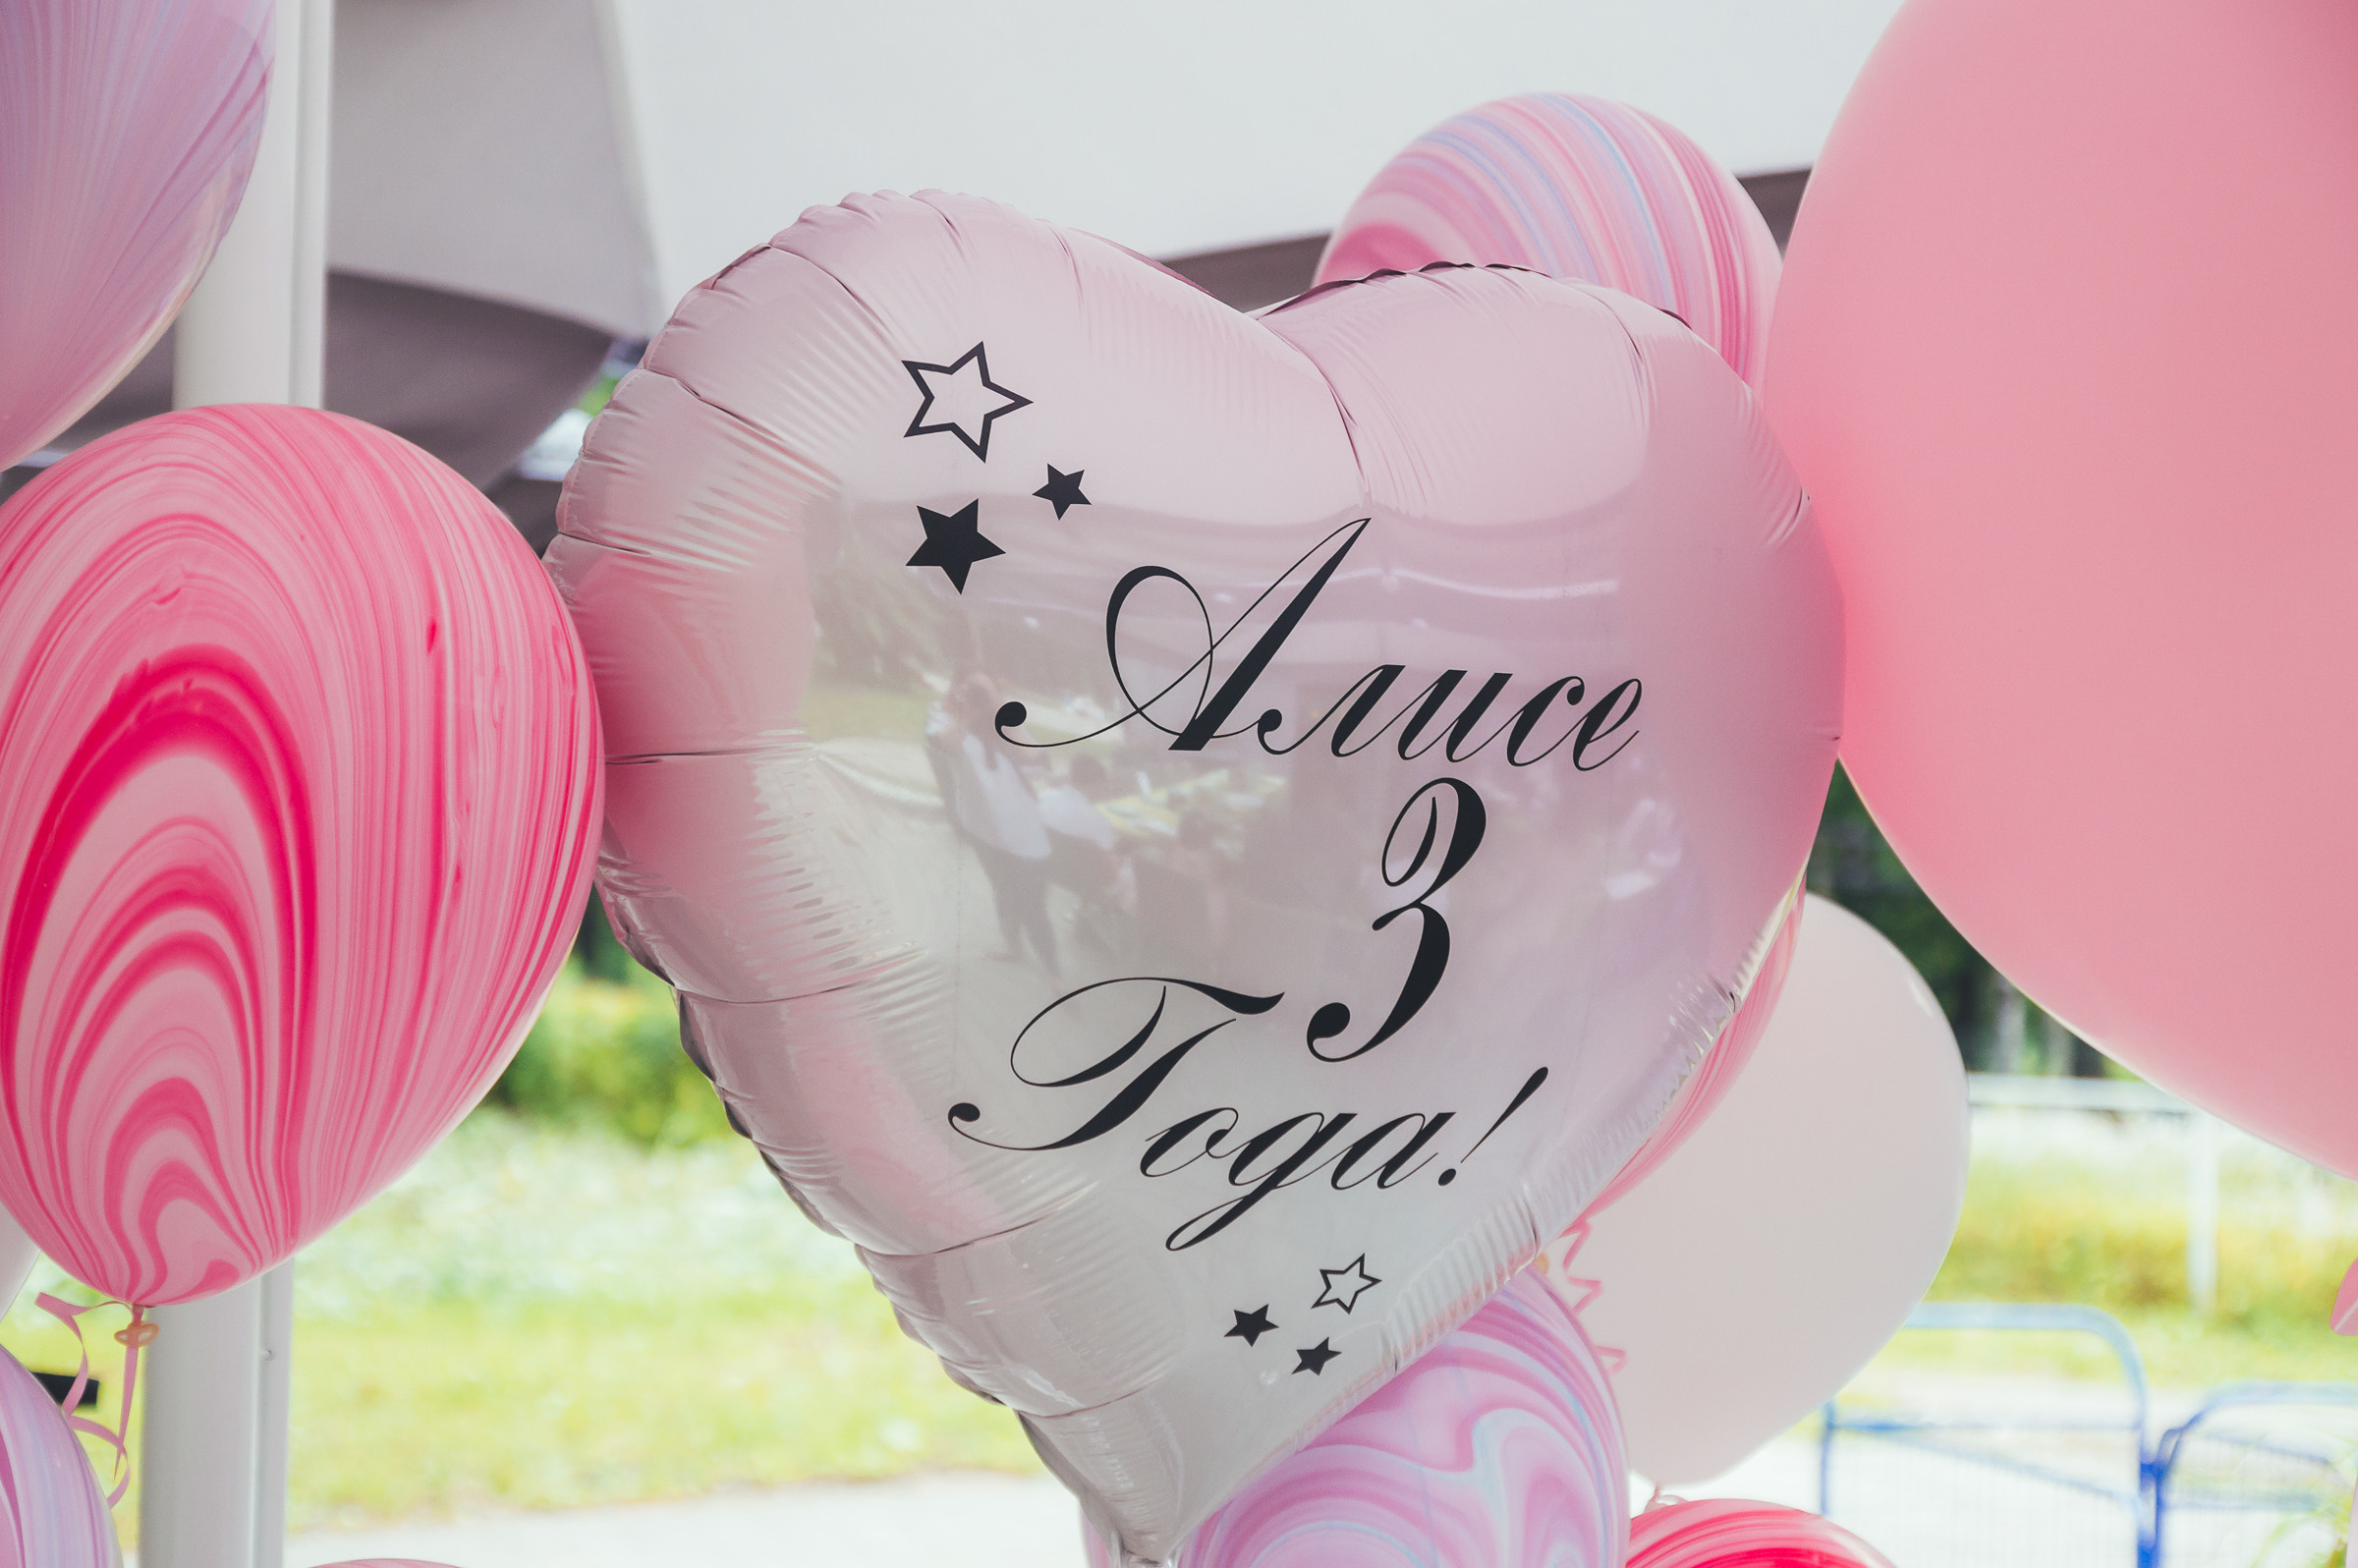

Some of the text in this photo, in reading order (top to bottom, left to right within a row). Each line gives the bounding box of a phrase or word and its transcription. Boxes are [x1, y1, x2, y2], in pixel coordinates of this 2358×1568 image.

[995, 518, 1644, 773] Алисе
[1306, 776, 1488, 1063] 3
[947, 977, 1549, 1252] Года!
